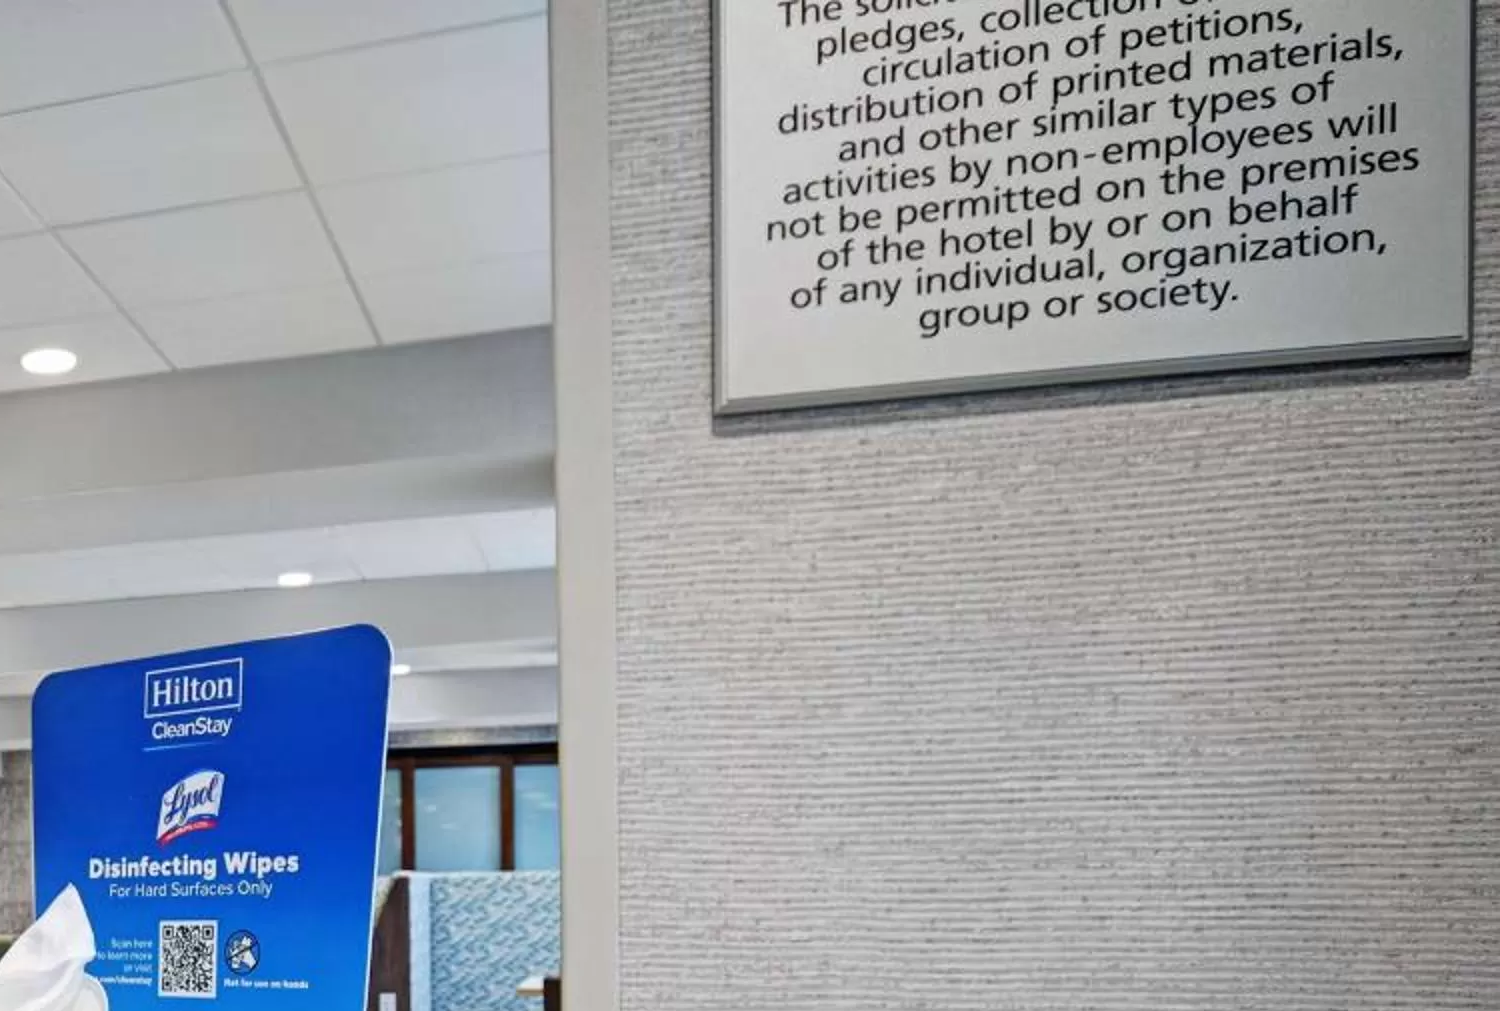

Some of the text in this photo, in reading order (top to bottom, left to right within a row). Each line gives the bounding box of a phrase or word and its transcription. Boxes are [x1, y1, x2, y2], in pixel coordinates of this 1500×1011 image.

[777, 0, 843, 28] The
[816, 18, 965, 67] pledges,
[862, 7, 1303, 88] circulation of petitions,
[777, 27, 1404, 135] distribution of printed materials,
[838, 69, 1336, 163] and other similar types of
[782, 101, 1398, 206] activities by non-employees will
[766, 145, 1420, 242] not be permitted on the premises
[816, 182, 1359, 272] of the hotel by or on behalf
[789, 225, 1387, 310] of any individual, organization,
[918, 277, 1240, 339] group or society.
[152, 675, 234, 708] Hilton
[151, 716, 233, 740] CleanStay
[164, 773, 220, 827] Lysol
[89, 850, 300, 881] Disinfecting Wipes
[109, 878, 273, 898] For Hard Surfaces Only
[107, 950, 128, 961] learn
[130, 952, 153, 961] more
[111, 937, 153, 949] Scan here
